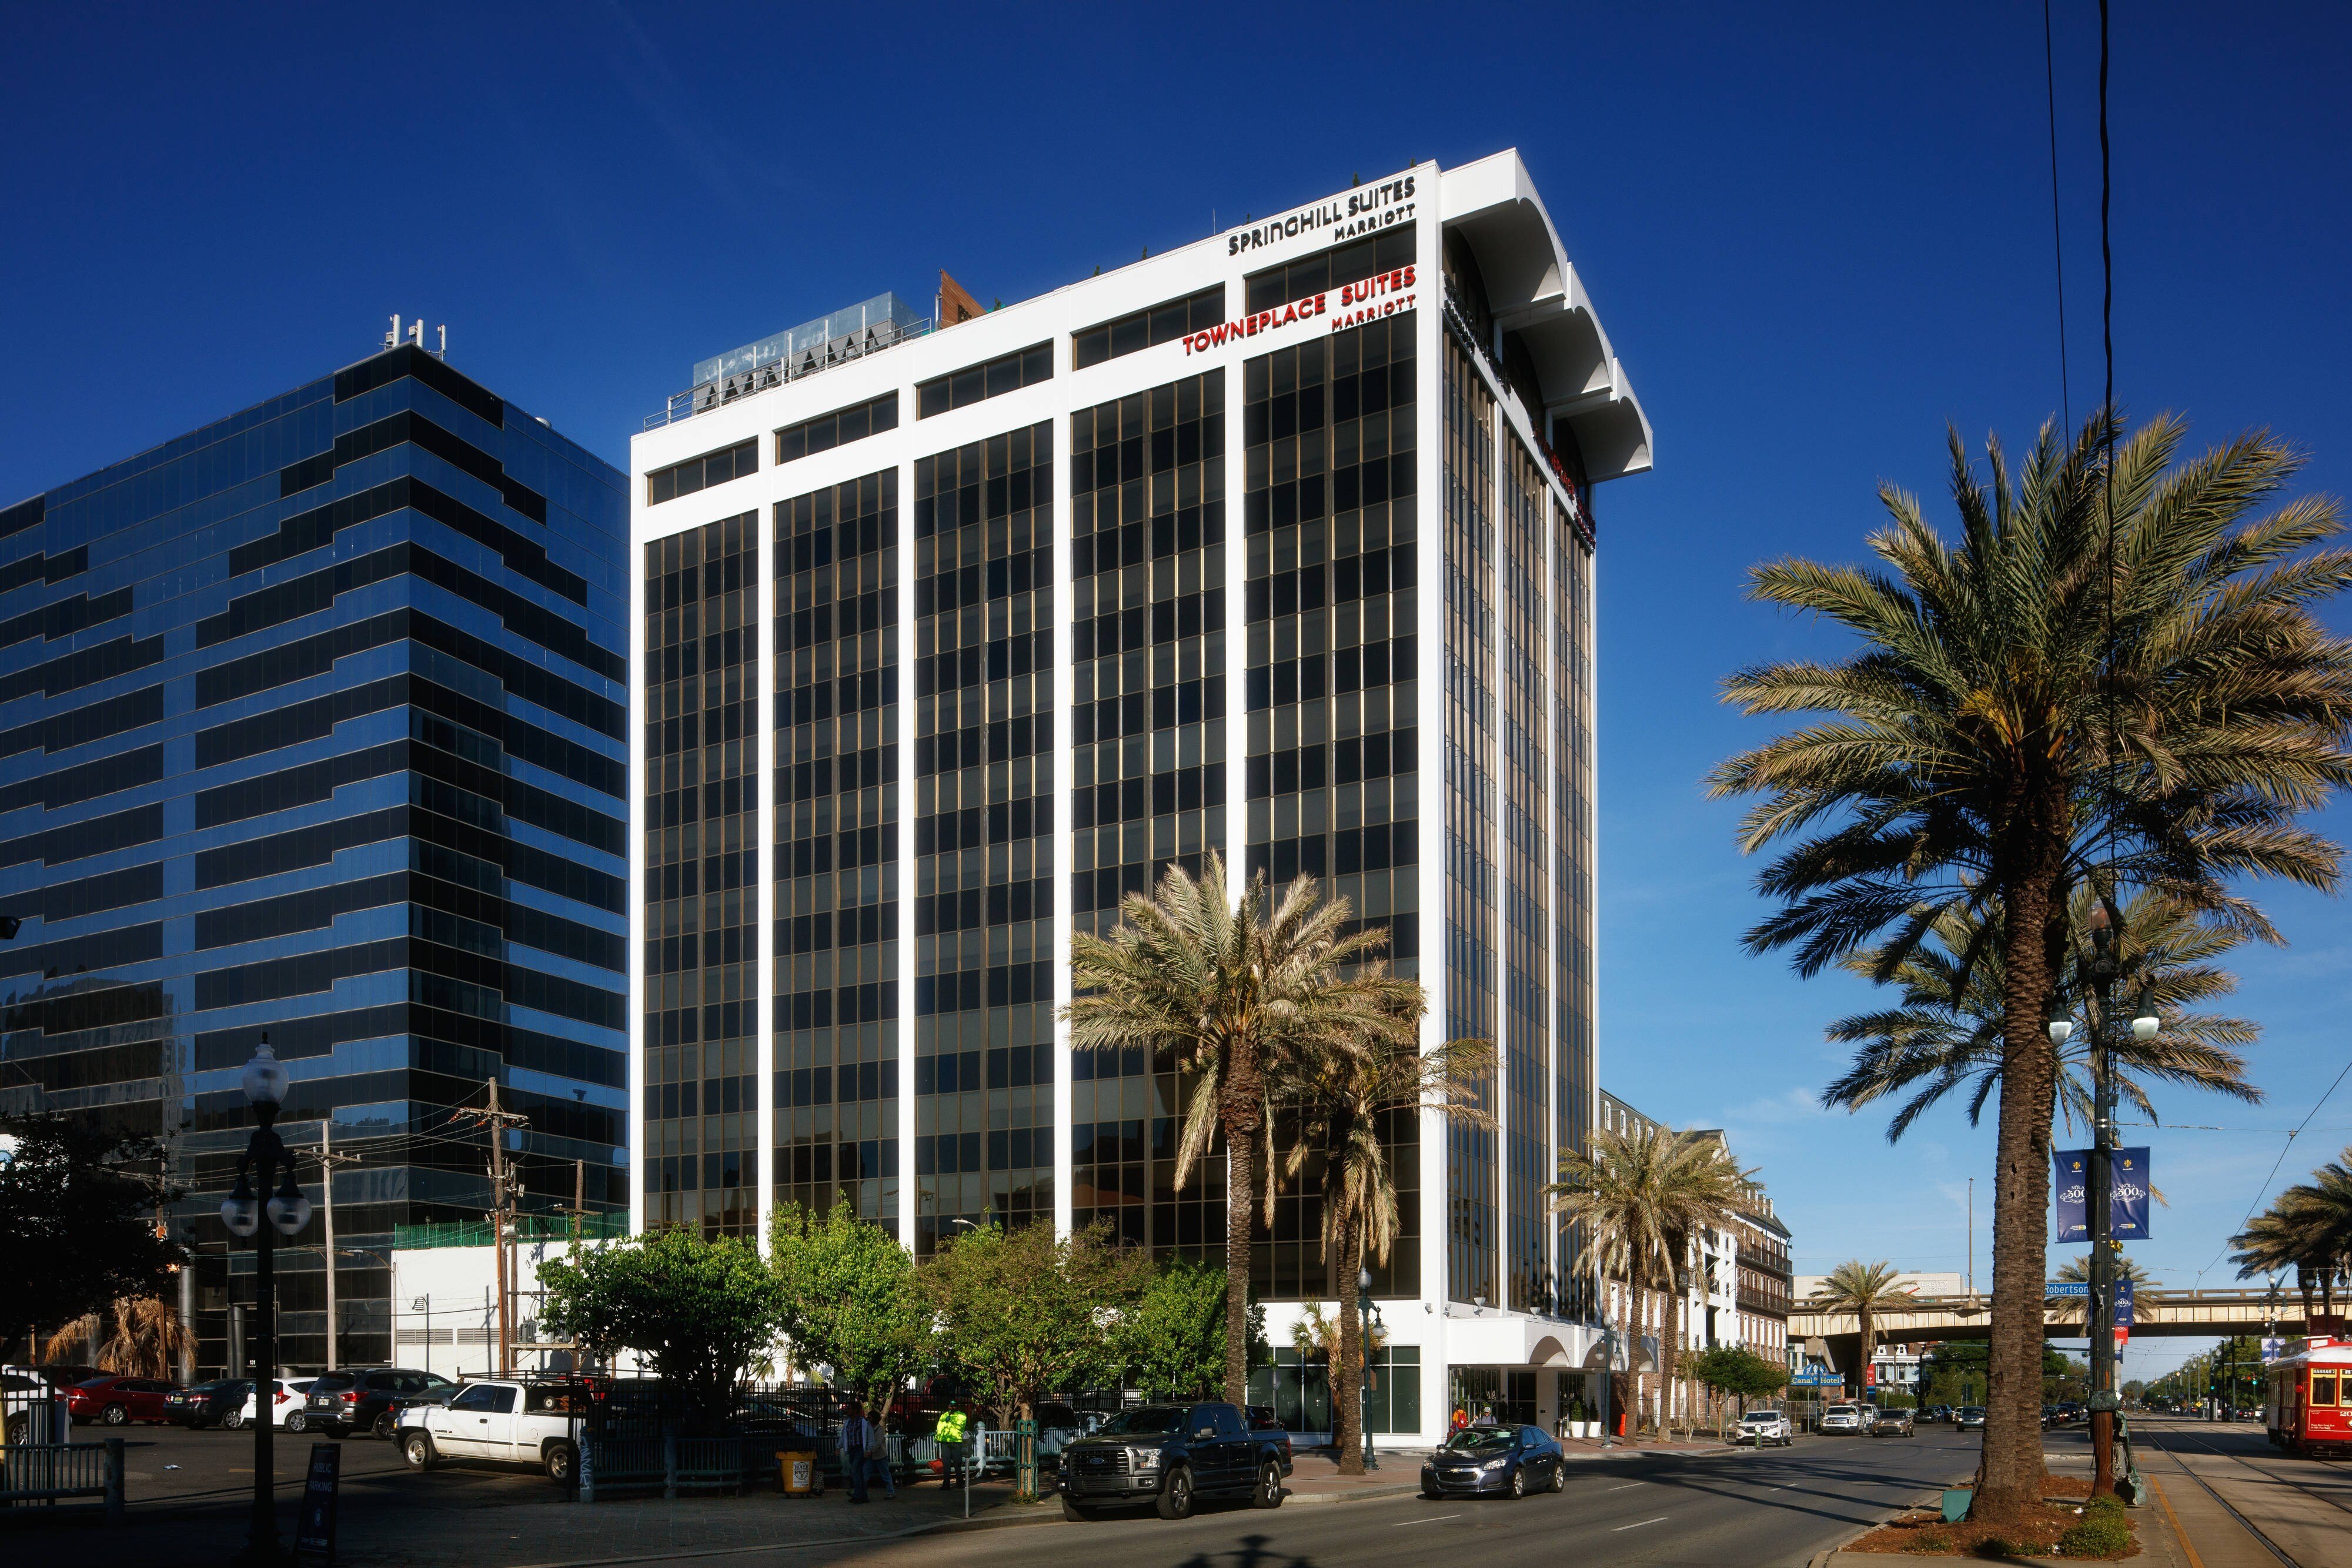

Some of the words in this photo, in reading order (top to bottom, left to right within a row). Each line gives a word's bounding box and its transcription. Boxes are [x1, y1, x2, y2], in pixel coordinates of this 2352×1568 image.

[1229, 202, 1342, 256] SPRINGHILL
[1348, 176, 1415, 217] SUITES
[1334, 203, 1415, 242] MARRIOTT
[1182, 293, 1327, 356] TOWNEPLACE
[1341, 266, 1416, 307] SUITES
[1332, 294, 1416, 332] MARRIOTT
[2117, 1188, 2139, 1196] 300
[2045, 1285, 2089, 1293] Robertson
[313, 1463, 332, 1473] PUBLIC
[309, 1480, 332, 1492] PARKING
